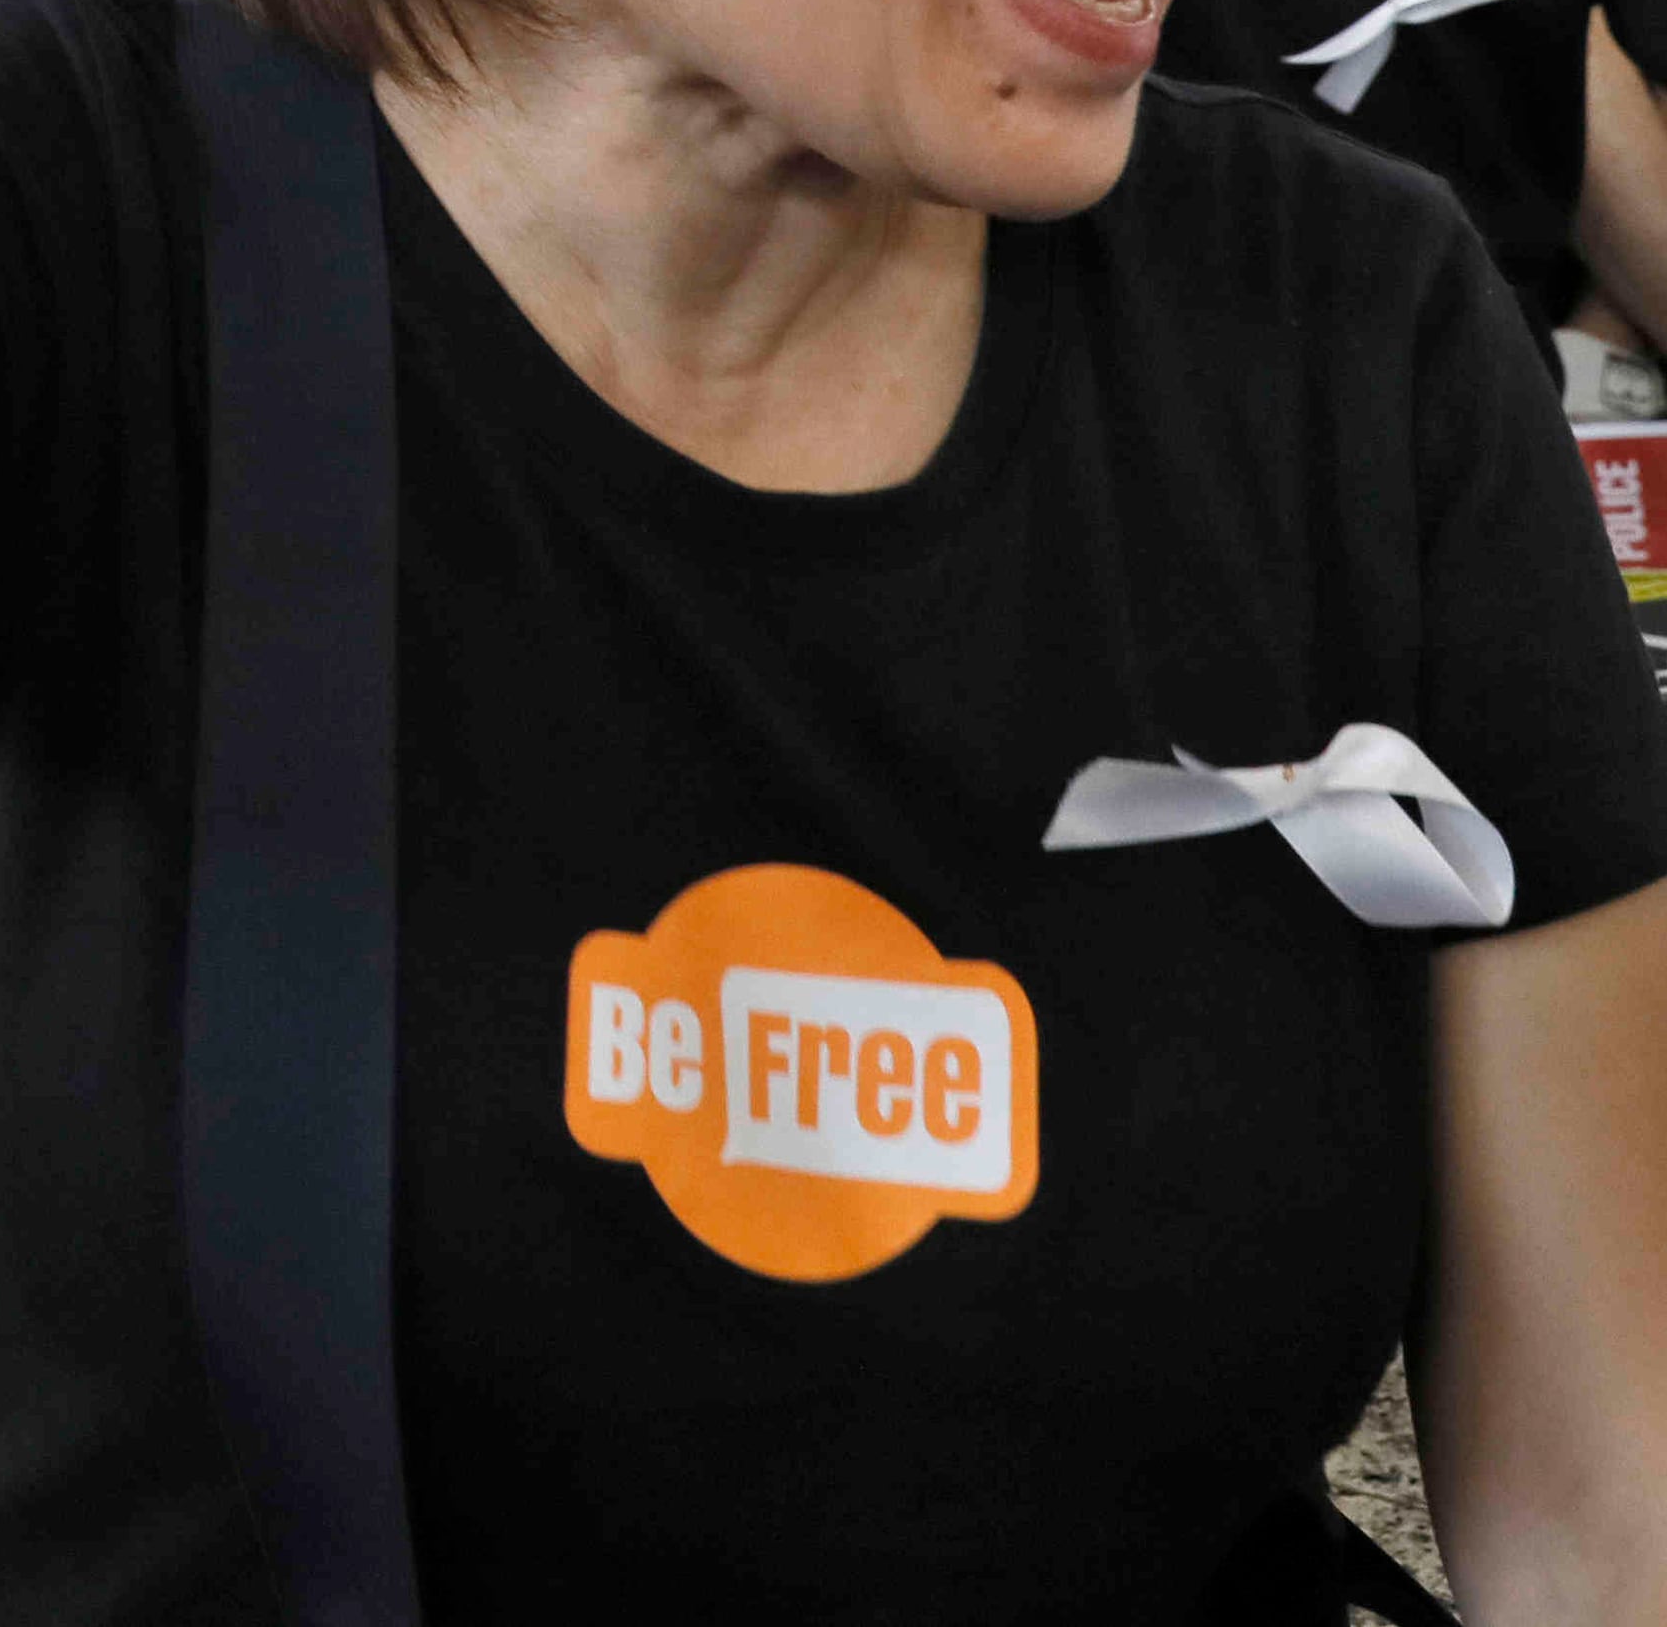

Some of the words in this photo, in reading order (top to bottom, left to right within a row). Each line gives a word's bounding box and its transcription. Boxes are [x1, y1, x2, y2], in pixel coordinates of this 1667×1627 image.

[1595, 459, 1649, 562] POLICE
[587, 981, 703, 1113] Be
[747, 1007, 982, 1145] Free
